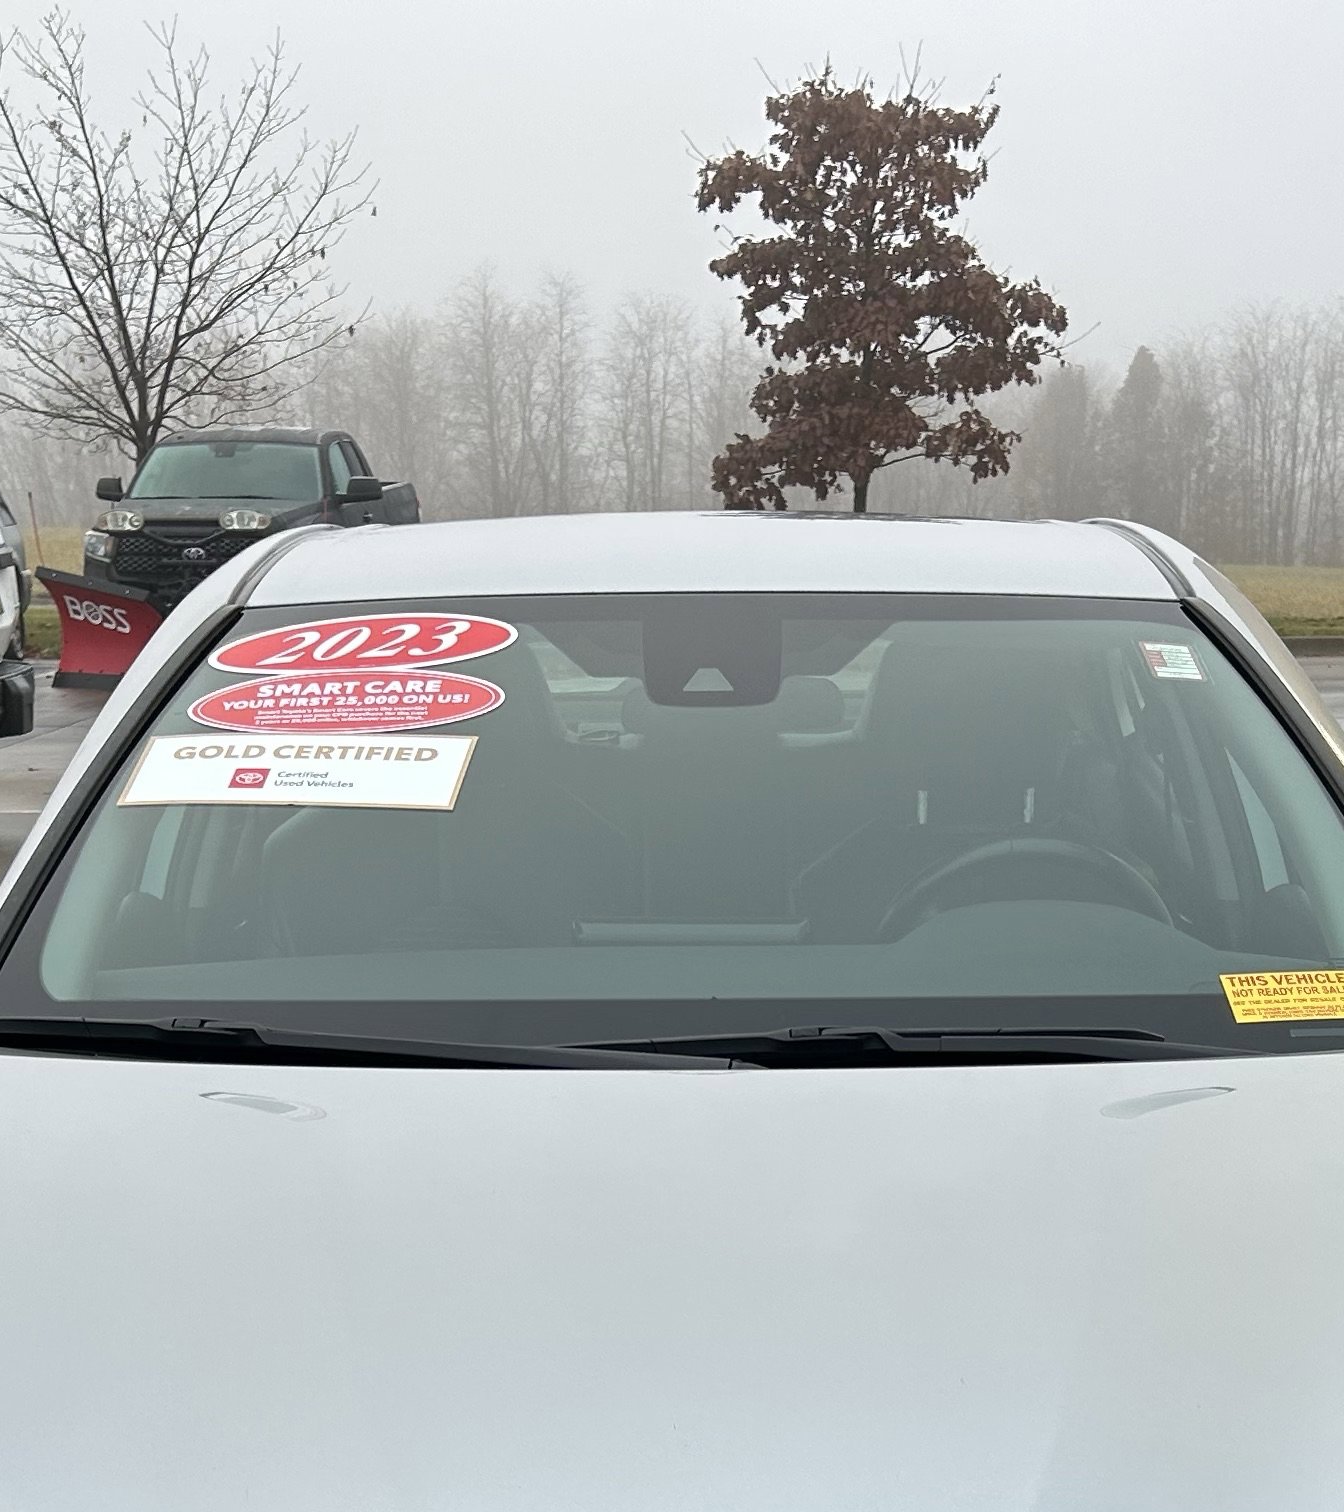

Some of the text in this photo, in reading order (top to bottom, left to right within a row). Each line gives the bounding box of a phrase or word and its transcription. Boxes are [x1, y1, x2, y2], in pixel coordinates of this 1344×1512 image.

[63, 595, 131, 634] BOSS
[256, 620, 471, 667] 2023
[256, 679, 442, 697] SMART CARE
[222, 693, 469, 711] YOUR FIRST 25,000 ON US!
[173, 745, 439, 762] GOLD CERTIFIED
[277, 771, 329, 779] Certified
[274, 780, 354, 788] Used Vehicles
[1225, 976, 1268, 987] THIS
[1232, 988, 1255, 998] NOT
[1257, 986, 1294, 997] READY
[1296, 986, 1320, 995] FOR
